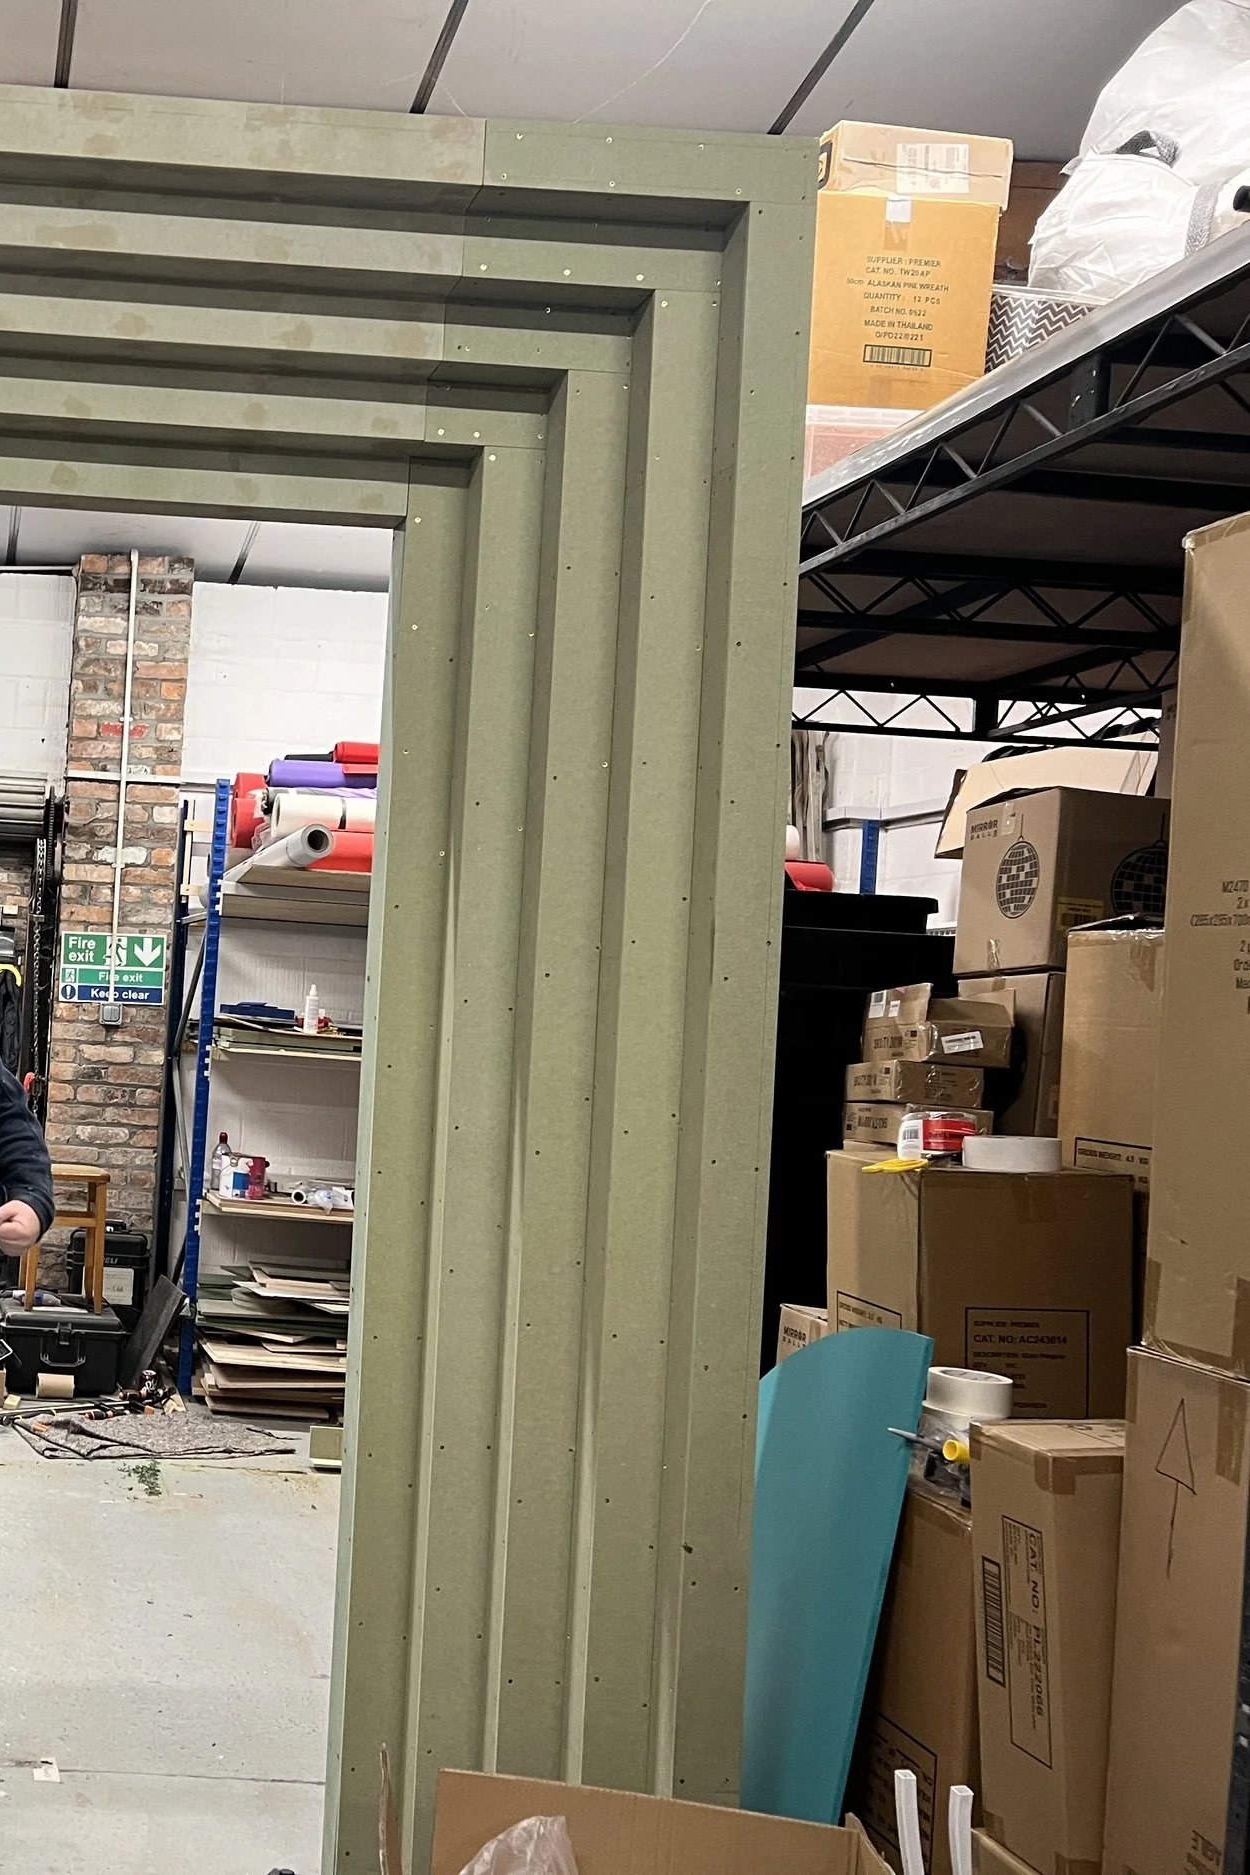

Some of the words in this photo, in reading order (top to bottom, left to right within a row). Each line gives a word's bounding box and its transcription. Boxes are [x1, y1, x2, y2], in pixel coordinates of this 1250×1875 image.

[866, 256, 903, 265] SUPPLIER
[908, 258, 941, 268] PREMIER
[868, 280, 902, 288] ALASKAN
[902, 282, 917, 290] PINE
[919, 283, 949, 292] WREATH
[864, 292, 902, 300] QUANTITY
[925, 296, 940, 305] PCS
[870, 306, 894, 314] BATCH
[864, 320, 886, 328] MADE
[888, 320, 895, 328] IN
[896, 321, 934, 331] THAILAND
[971, 820, 998, 834] MIRROR
[68, 936, 96, 950] Fire
[68, 950, 94, 962] exit
[98, 971, 120, 982] Fie
[122, 973, 144, 982] exit
[122, 990, 150, 1000] clear
[104, 1256, 118, 1264] ELI
[784, 1326, 806, 1343] MIRROR
[1030, 1534, 1038, 1573] CAT.
